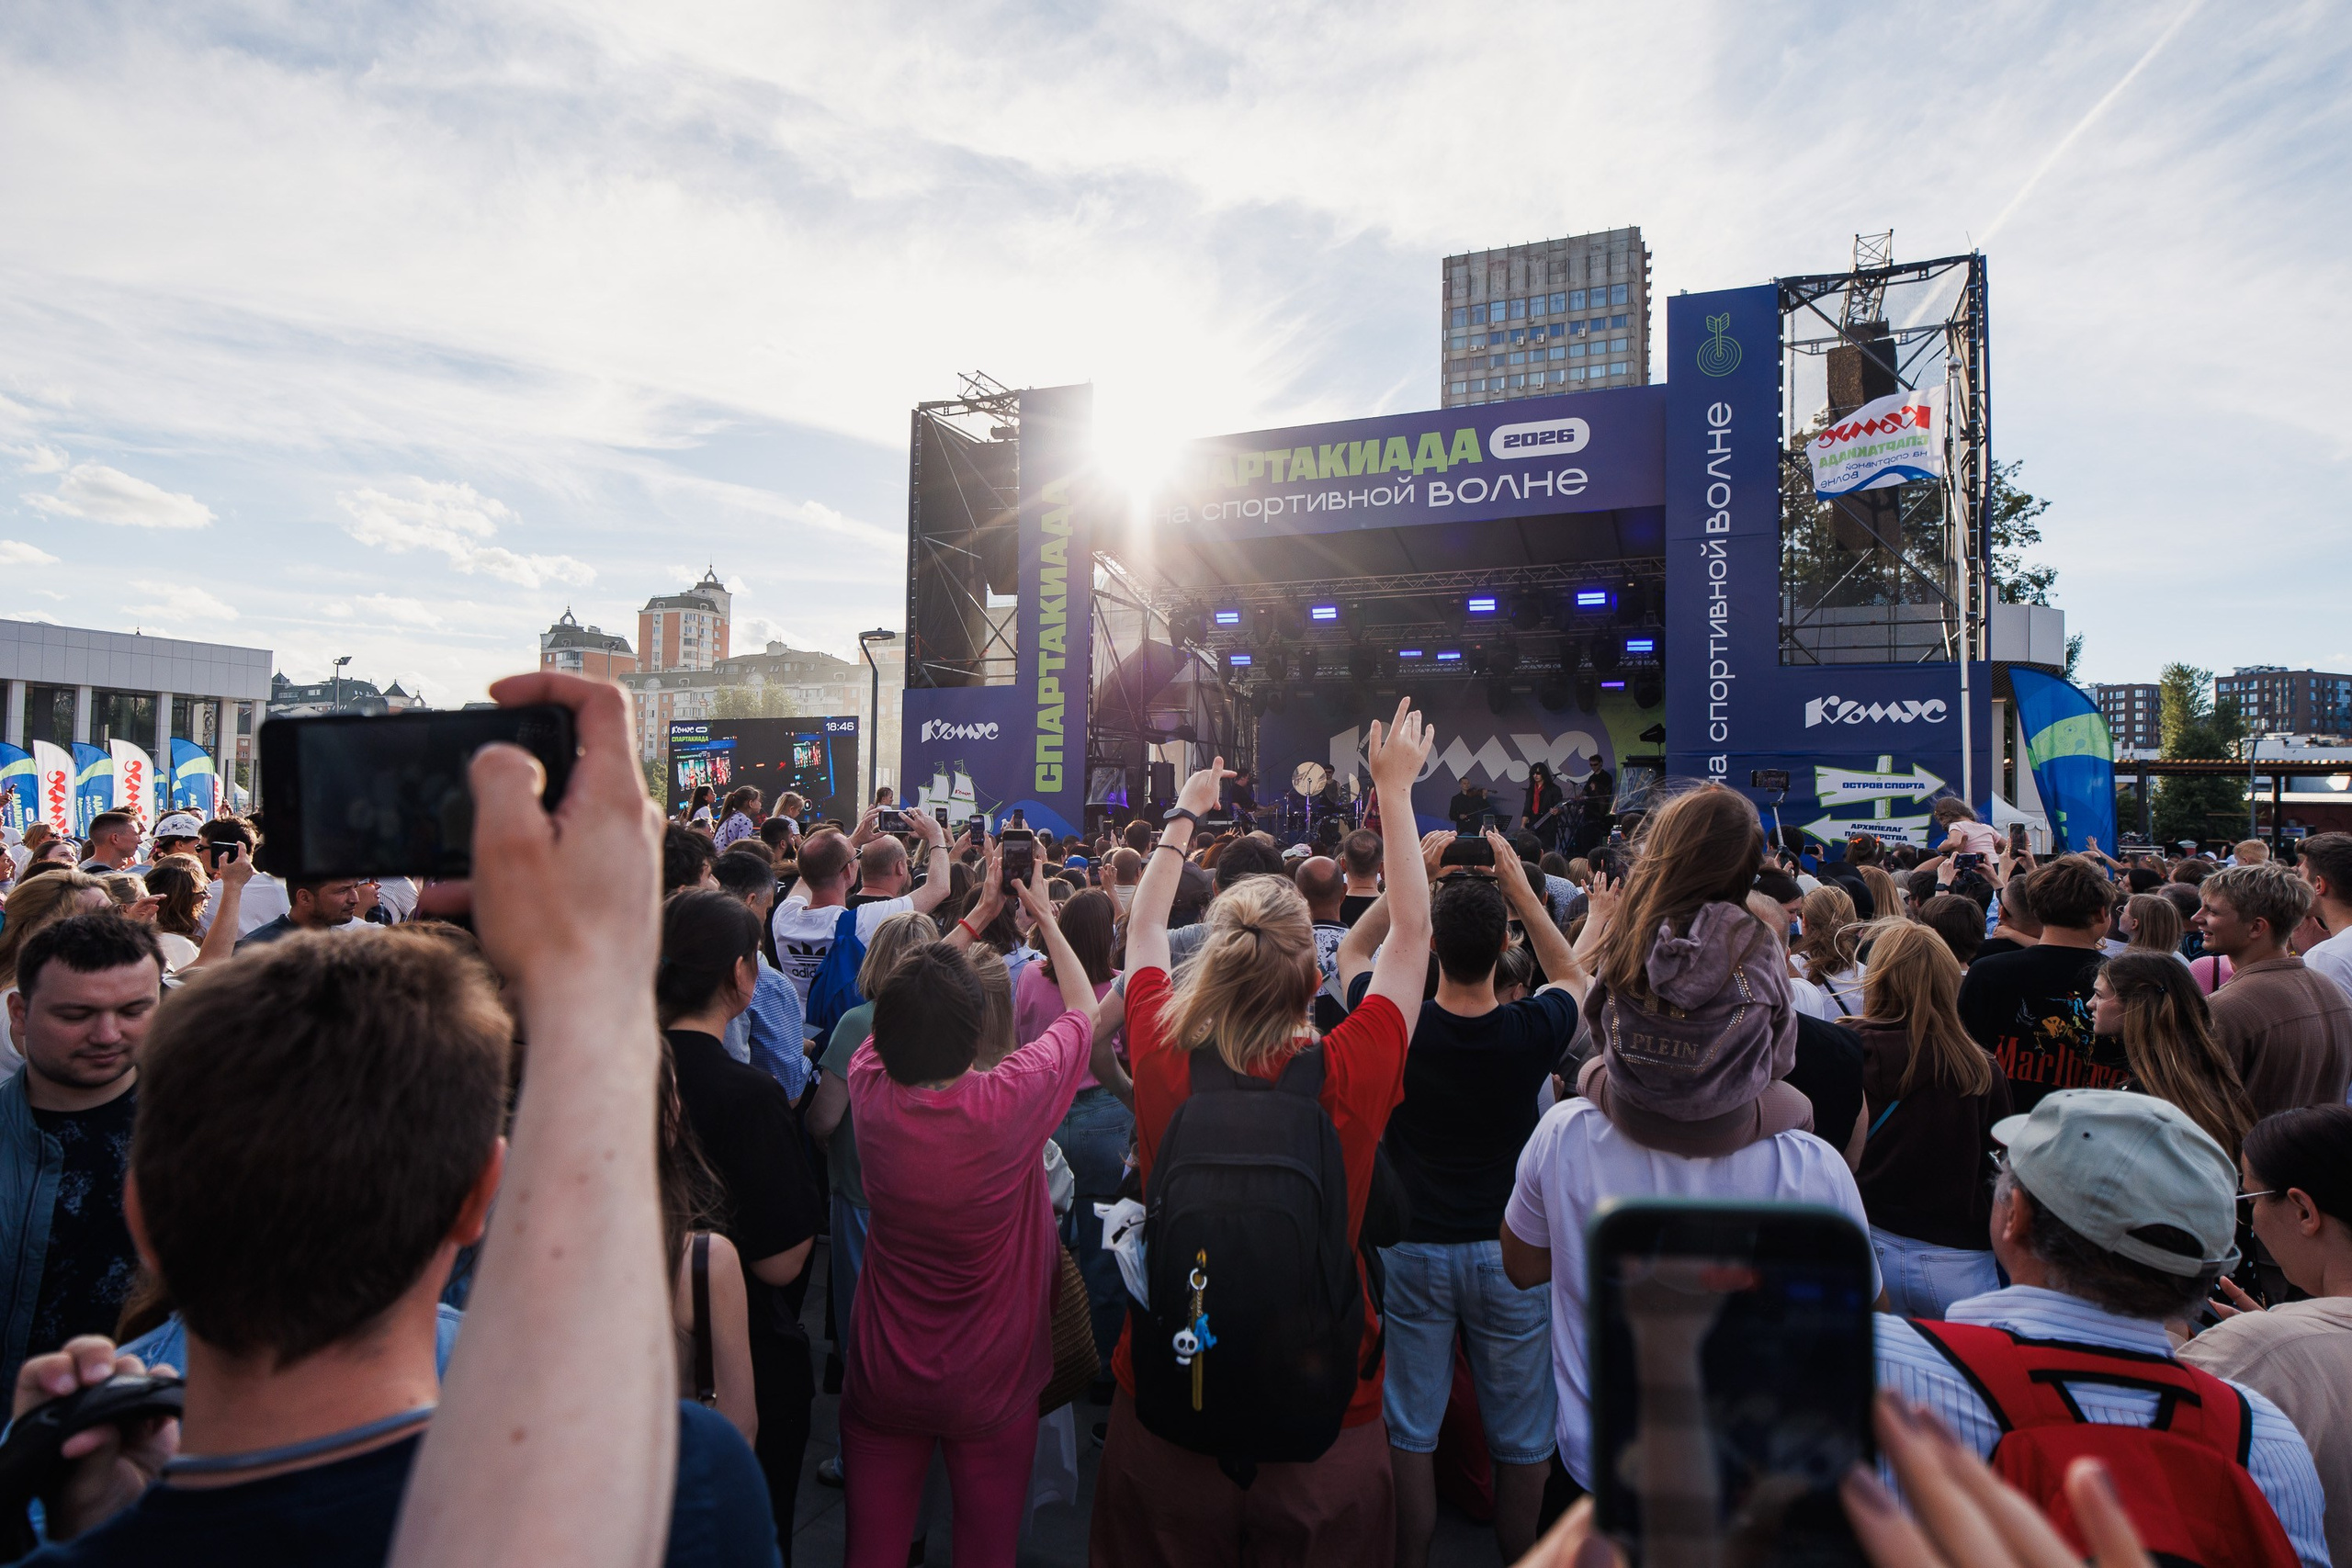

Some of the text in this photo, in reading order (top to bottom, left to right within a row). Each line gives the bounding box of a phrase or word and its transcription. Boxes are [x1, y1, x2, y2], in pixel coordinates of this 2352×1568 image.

[1205, 427, 1575, 490] АРТАКИАДА 2026
[1202, 475, 1414, 524] спортивной
[1035, 476, 1074, 793] СПАРТАКИАДА
[1701, 539, 1736, 742] спортивной
[825, 722, 854, 731] 18:46
[1883, 782, 1926, 790] СПОРТА
[1844, 830, 1908, 841] ПАЕРСТВА
[1850, 823, 1904, 833] АРХИПЕЛАГ
[792, 967, 816, 978] adid
[1630, 1032, 1699, 1061] PLEIN
